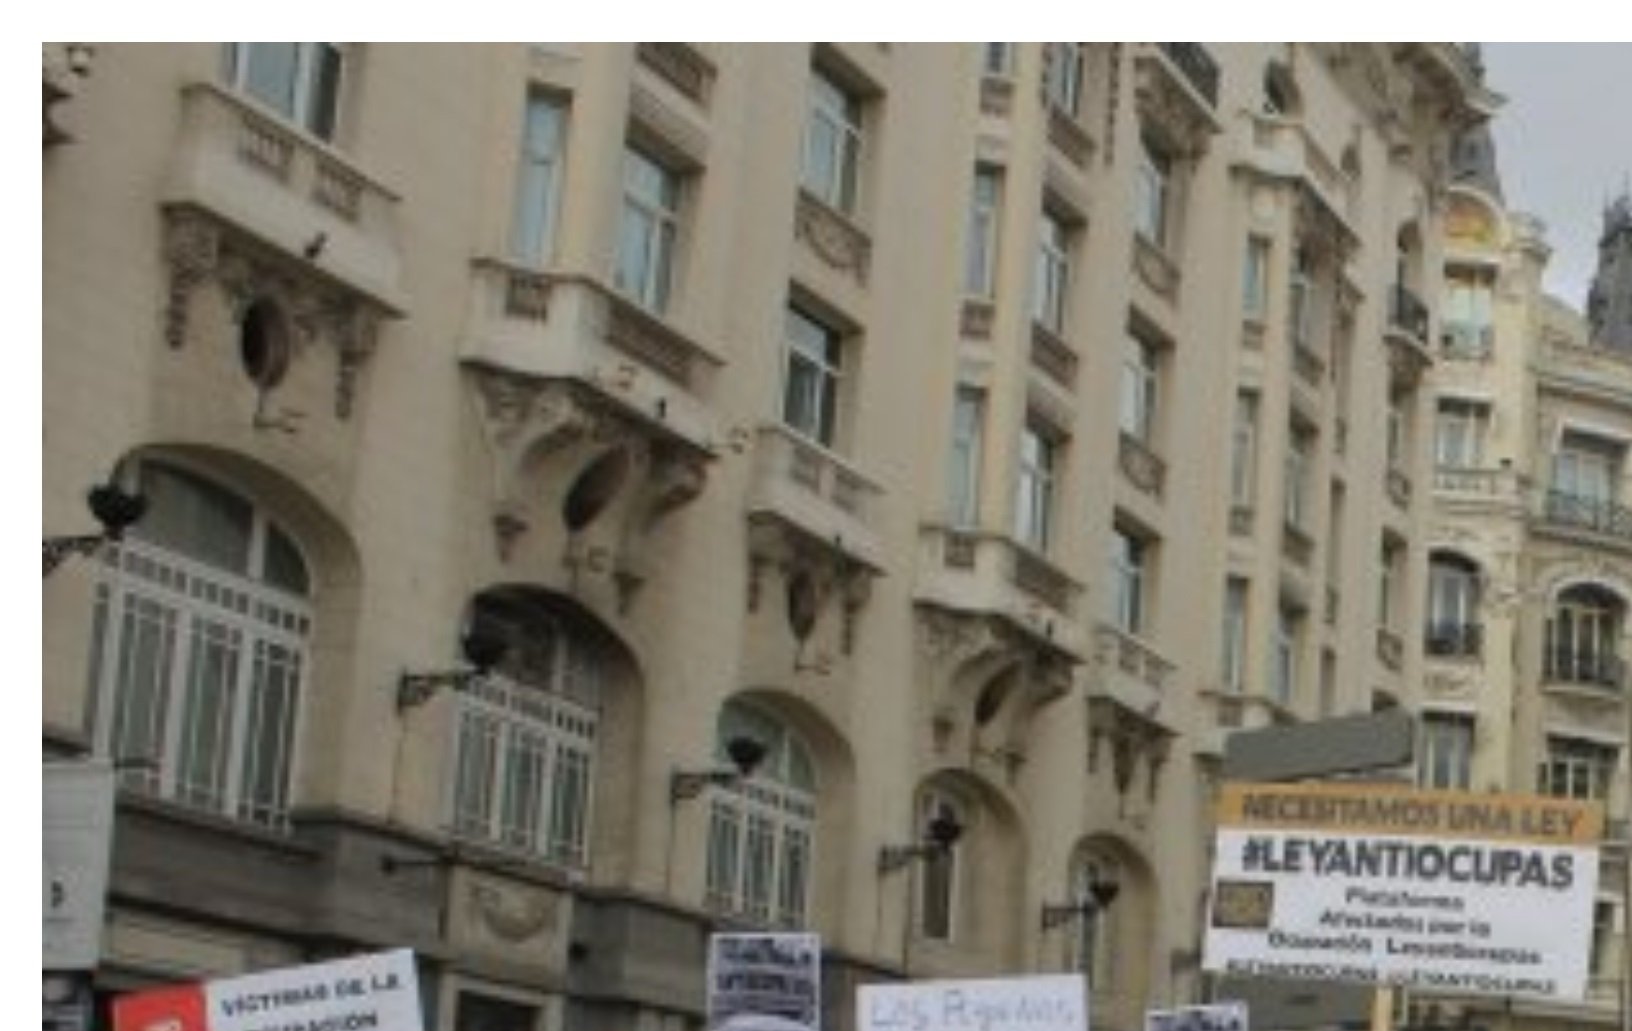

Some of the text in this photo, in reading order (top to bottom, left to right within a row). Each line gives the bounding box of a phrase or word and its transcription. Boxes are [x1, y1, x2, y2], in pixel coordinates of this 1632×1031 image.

[1448, 806, 1514, 832] UNA
[1519, 809, 1584, 837] LEY
[1243, 837, 1574, 888] #LEYANTIOCUPAS
